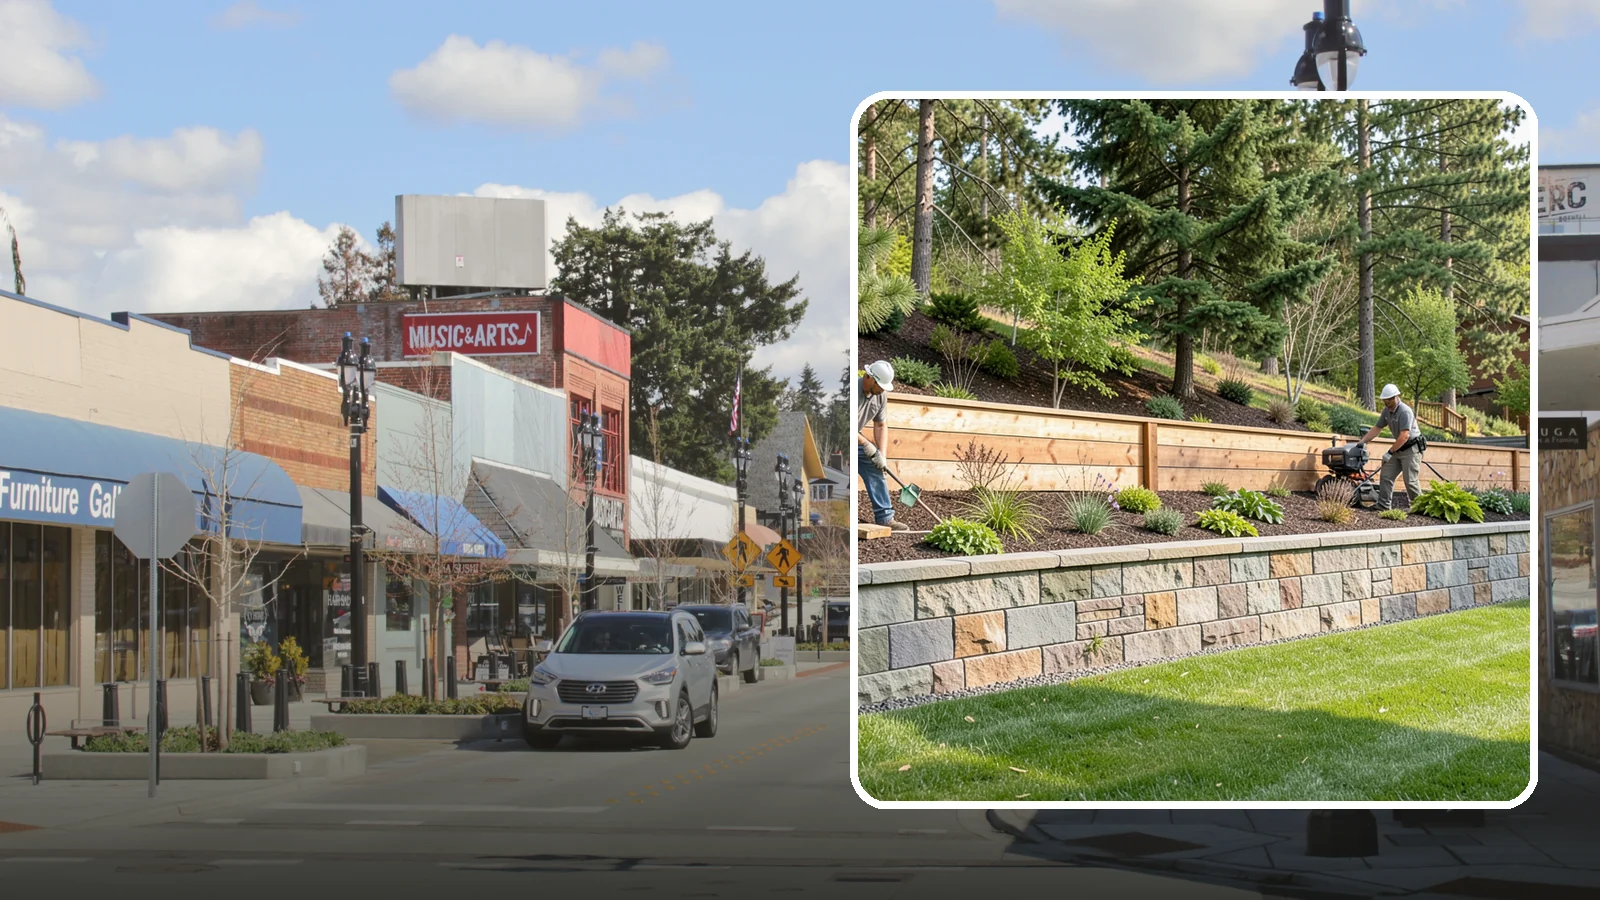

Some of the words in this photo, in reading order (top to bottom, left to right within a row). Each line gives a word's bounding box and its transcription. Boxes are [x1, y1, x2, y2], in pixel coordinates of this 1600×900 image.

[1541, 428, 1578, 436] UGA
[0, 472, 79, 515] Furniture
[89, 483, 121, 518] Gal
